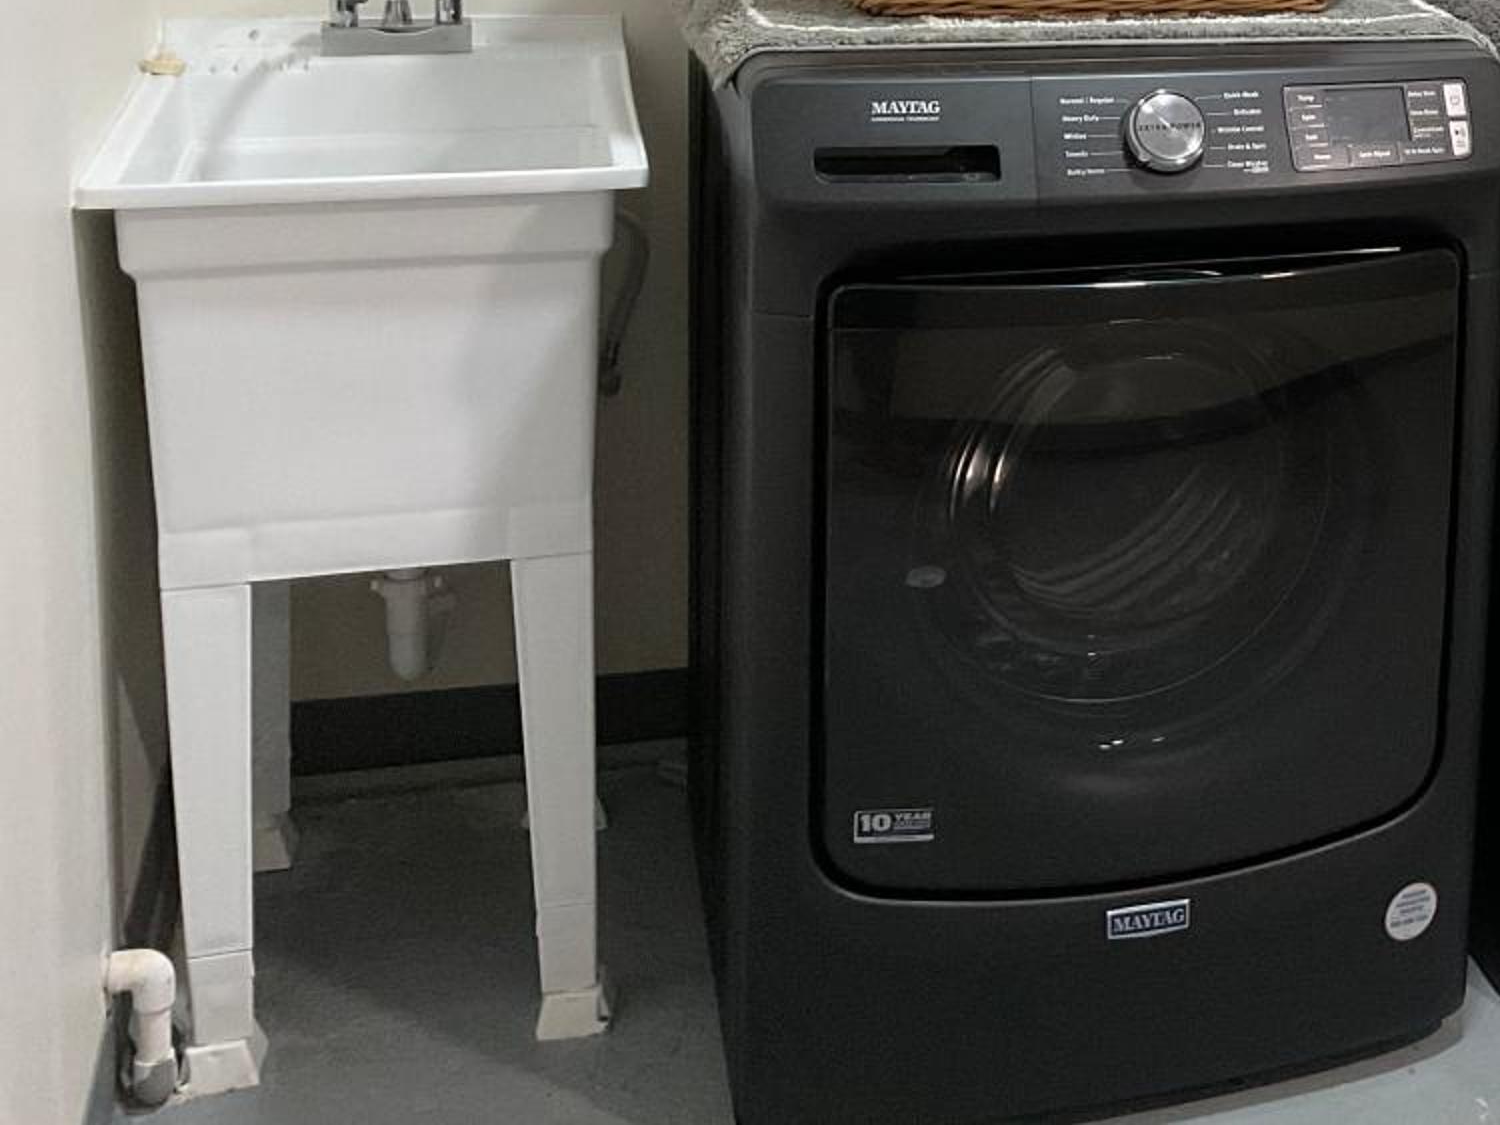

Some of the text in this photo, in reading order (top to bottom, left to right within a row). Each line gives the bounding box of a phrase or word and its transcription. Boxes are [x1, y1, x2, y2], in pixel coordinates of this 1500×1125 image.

[871, 99, 941, 115] MAYTAG
[861, 813, 892, 832] 10
[1113, 907, 1185, 933] MAYTAG
